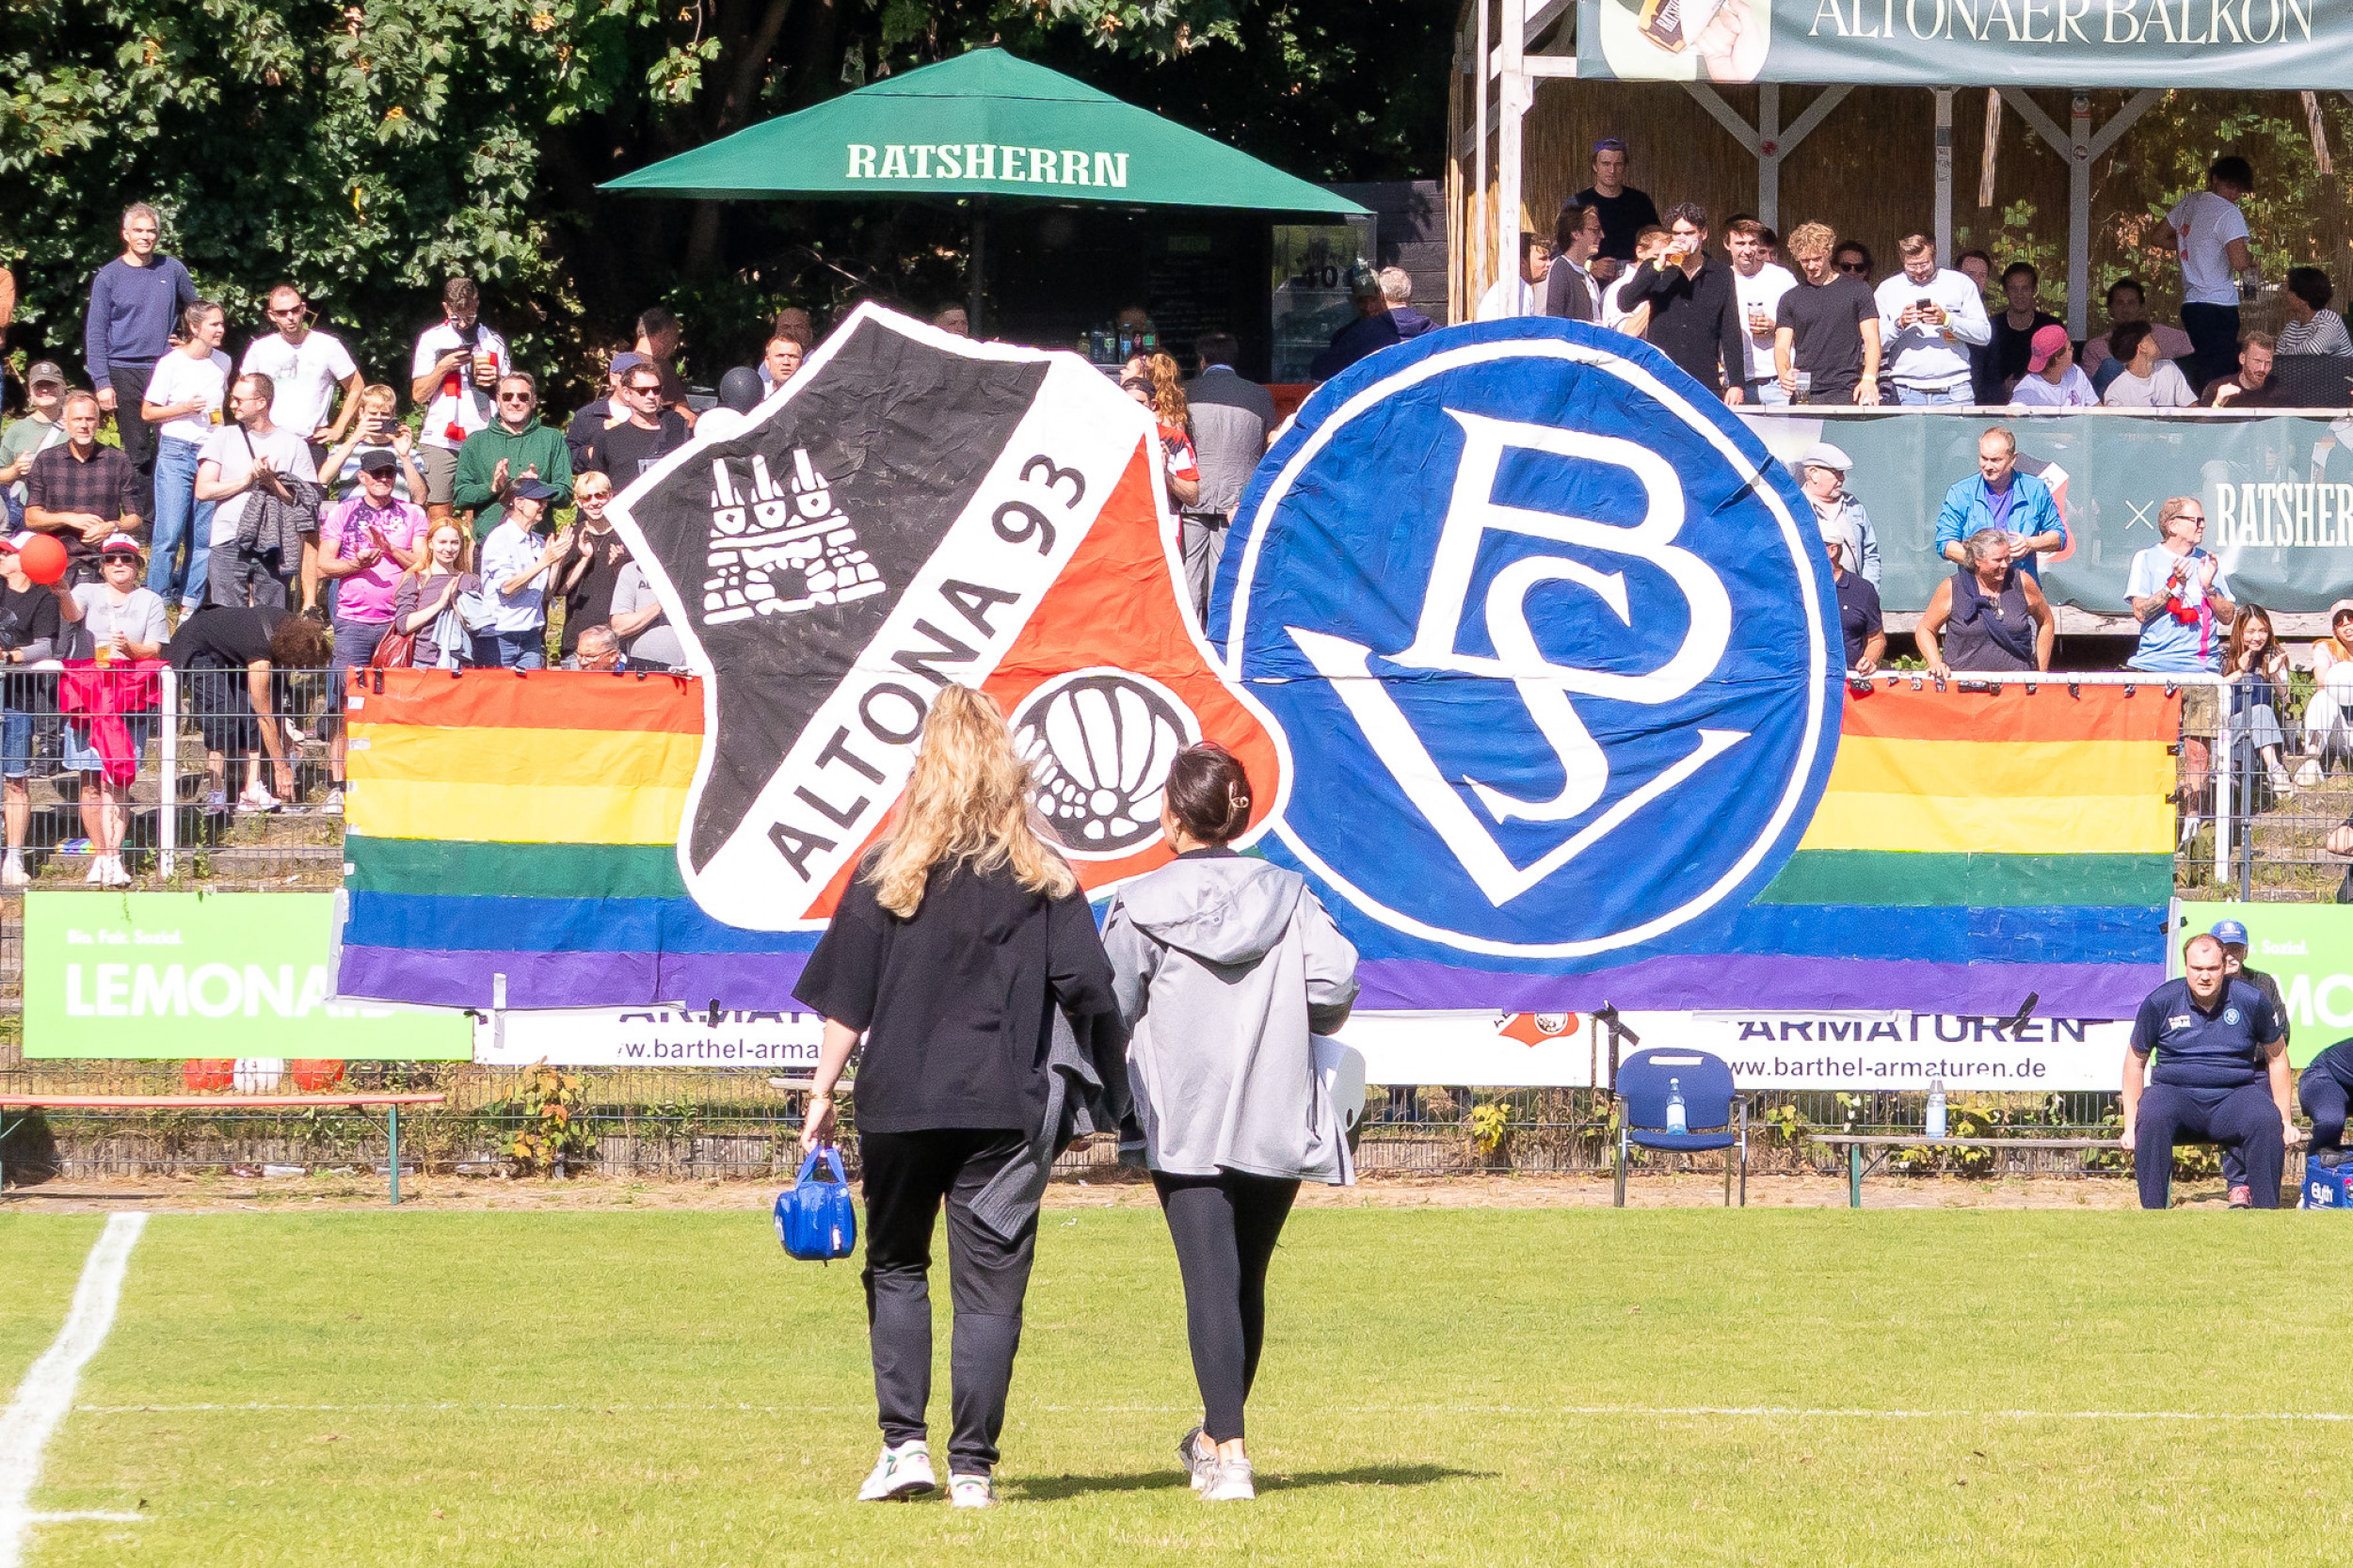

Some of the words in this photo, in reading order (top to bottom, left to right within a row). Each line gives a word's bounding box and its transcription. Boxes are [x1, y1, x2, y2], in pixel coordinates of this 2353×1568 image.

[1807, 0, 2091, 44] ALTONAER
[2103, 0, 2313, 44] BALKON
[845, 144, 1129, 187] RATSHERRN
[766, 578, 1021, 883] ALTONA
[991, 454, 1086, 556] 93
[66, 963, 396, 1017] LEMONA
[617, 1038, 821, 1059] w.barthel-arma
[1730, 1056, 2046, 1079] ww.barthel-armaturen.de
